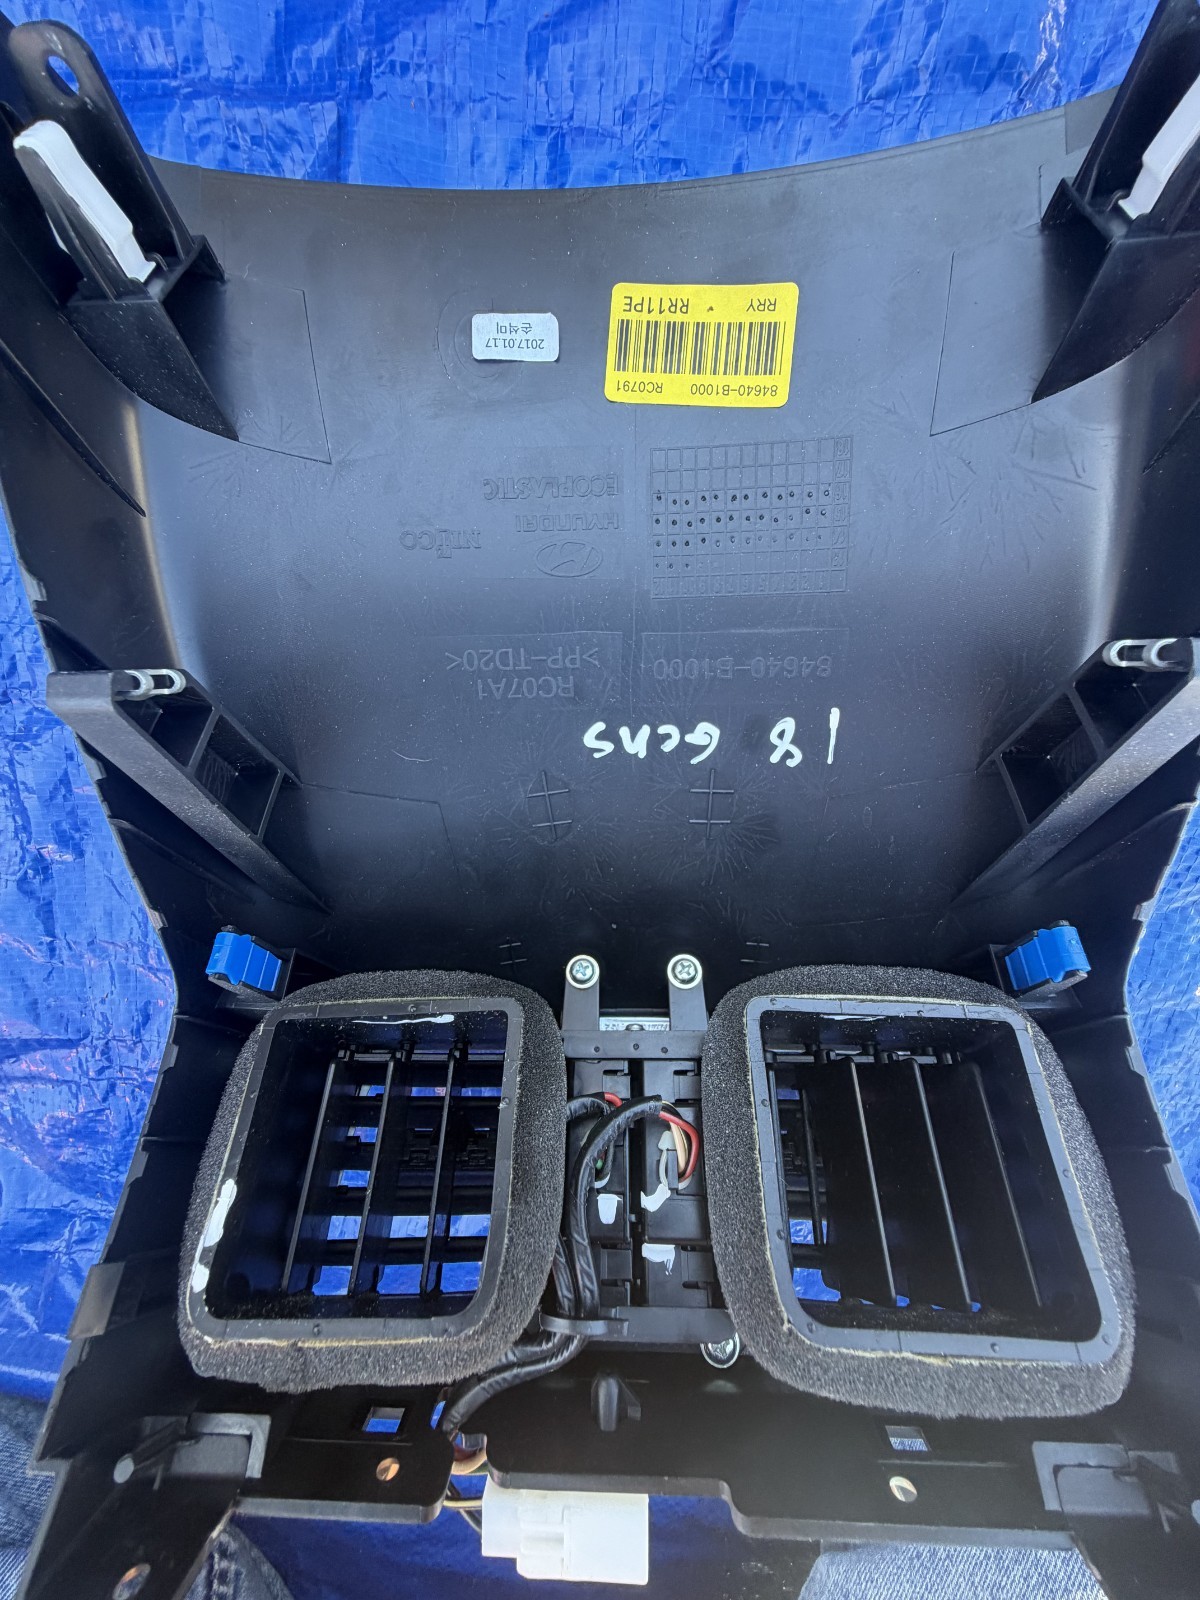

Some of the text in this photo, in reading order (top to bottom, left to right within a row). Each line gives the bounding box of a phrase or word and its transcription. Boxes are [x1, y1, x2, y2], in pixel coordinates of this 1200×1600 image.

[623, 296, 777, 314] RRY RR11PE
[496, 322, 532, 335] 손석미
[486, 338, 544, 349] 2017.01.17
[616, 380, 778, 396] 84640-B1000 RC0791
[482, 474, 619, 501] ECOPLASTIC
[515, 513, 619, 532] HYUNDAI
[445, 646, 599, 671] >PP-TD20<
[653, 655, 832, 679] 84640-B1000
[477, 675, 575, 699] RC07A1
